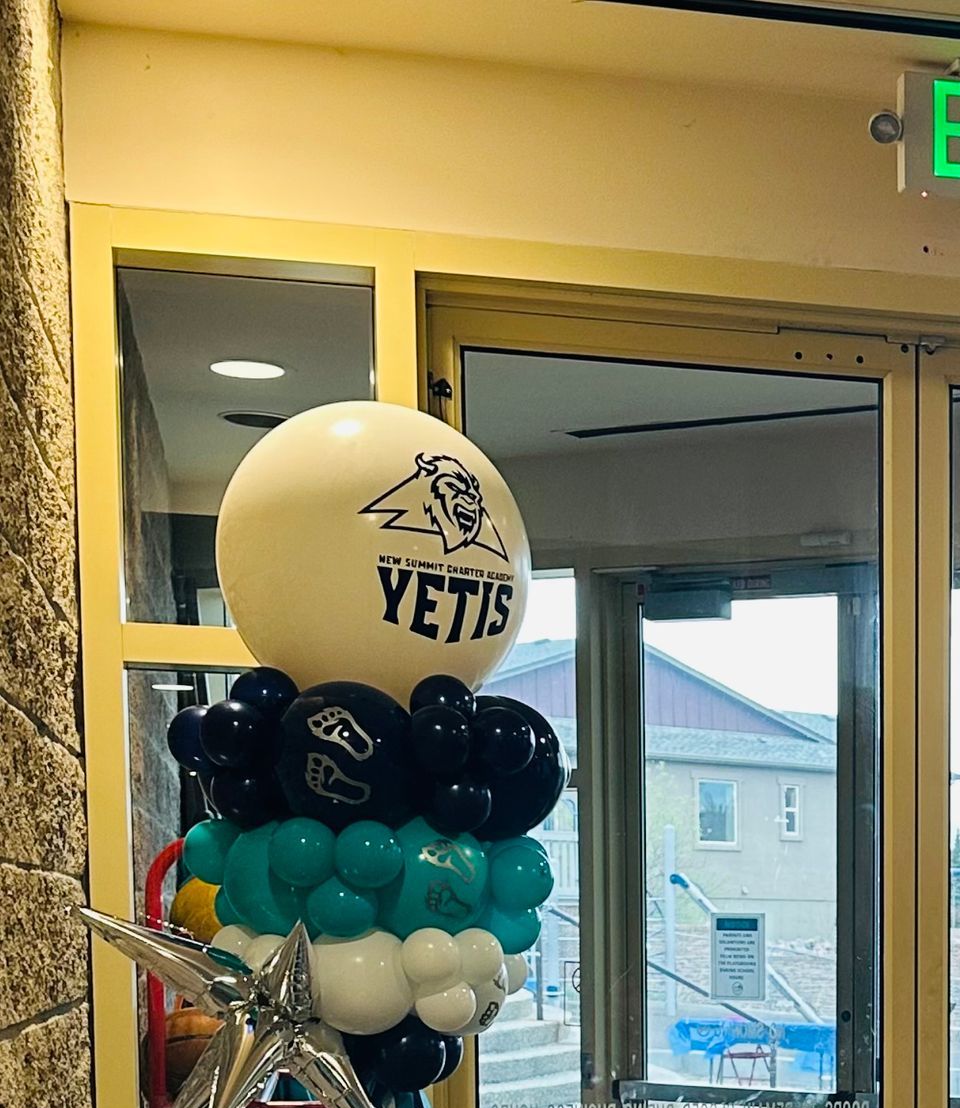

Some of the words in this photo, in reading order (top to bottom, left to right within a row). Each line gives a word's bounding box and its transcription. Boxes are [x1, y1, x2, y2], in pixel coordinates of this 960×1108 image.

[379, 554, 401, 566] NEW
[405, 558, 445, 572] SUMMIT
[447, 564, 484, 579] CHARTER
[487, 571, 515, 582] ACADEMY
[377, 565, 513, 644] YETIS
